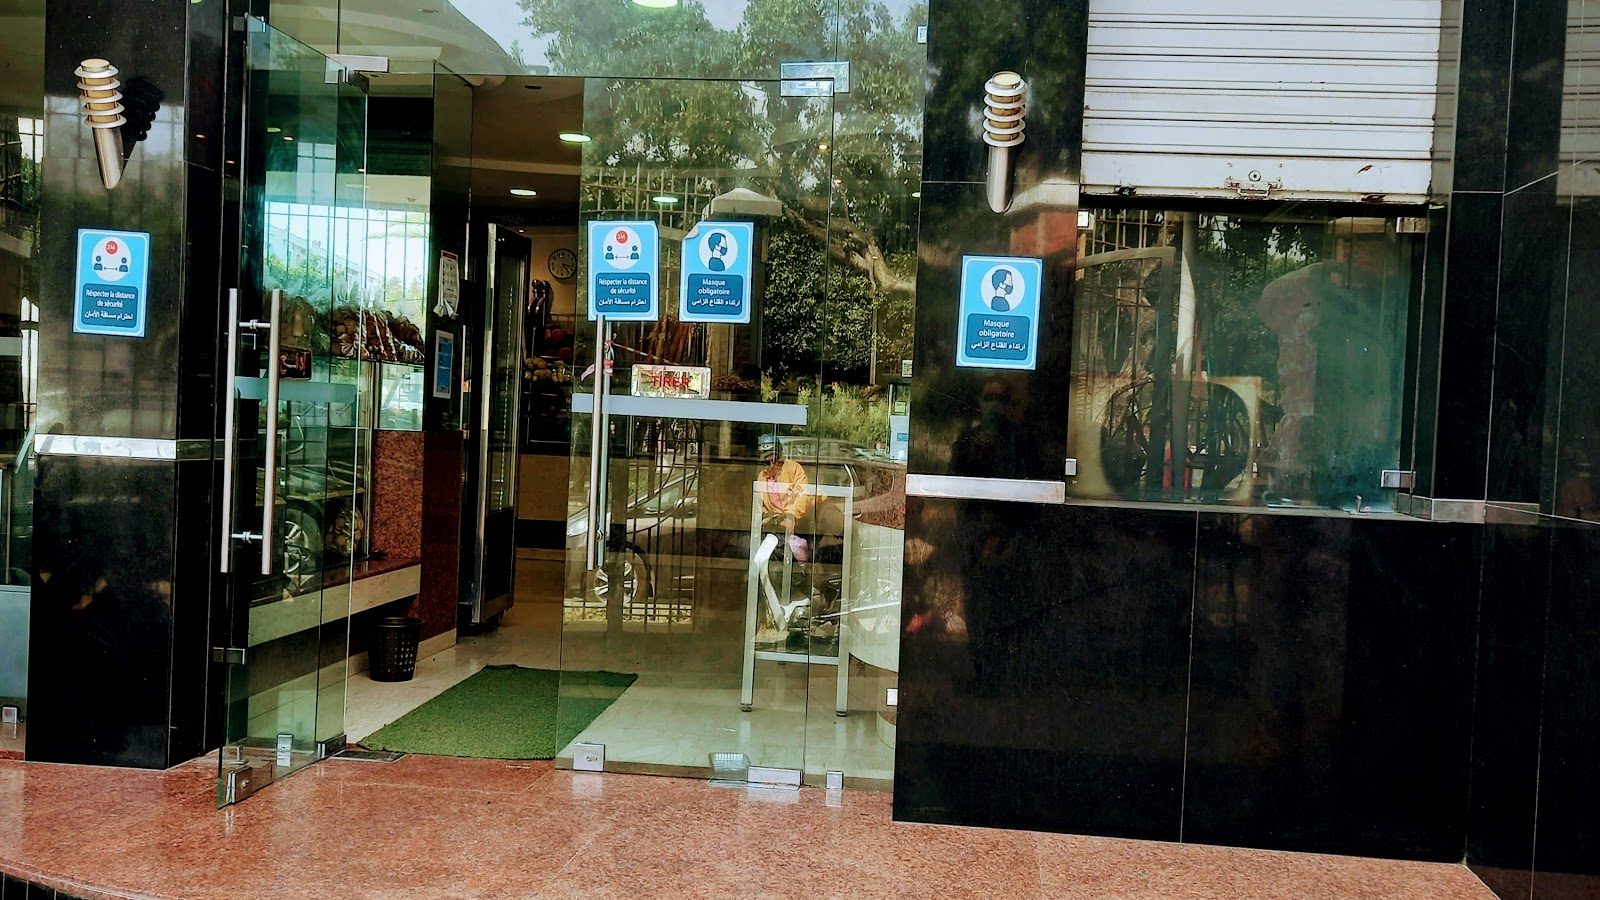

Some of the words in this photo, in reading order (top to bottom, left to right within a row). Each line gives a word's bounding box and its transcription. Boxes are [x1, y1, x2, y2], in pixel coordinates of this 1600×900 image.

[628, 278, 648, 286] distance
[702, 279, 726, 287] Masque
[114, 290, 136, 300] distance
[617, 287, 637, 295] sécurité
[697, 288, 731, 296] obligatoire
[104, 300, 124, 308] sécurité
[983, 319, 1010, 329] Masque
[978, 329, 1015, 339] obligatoire
